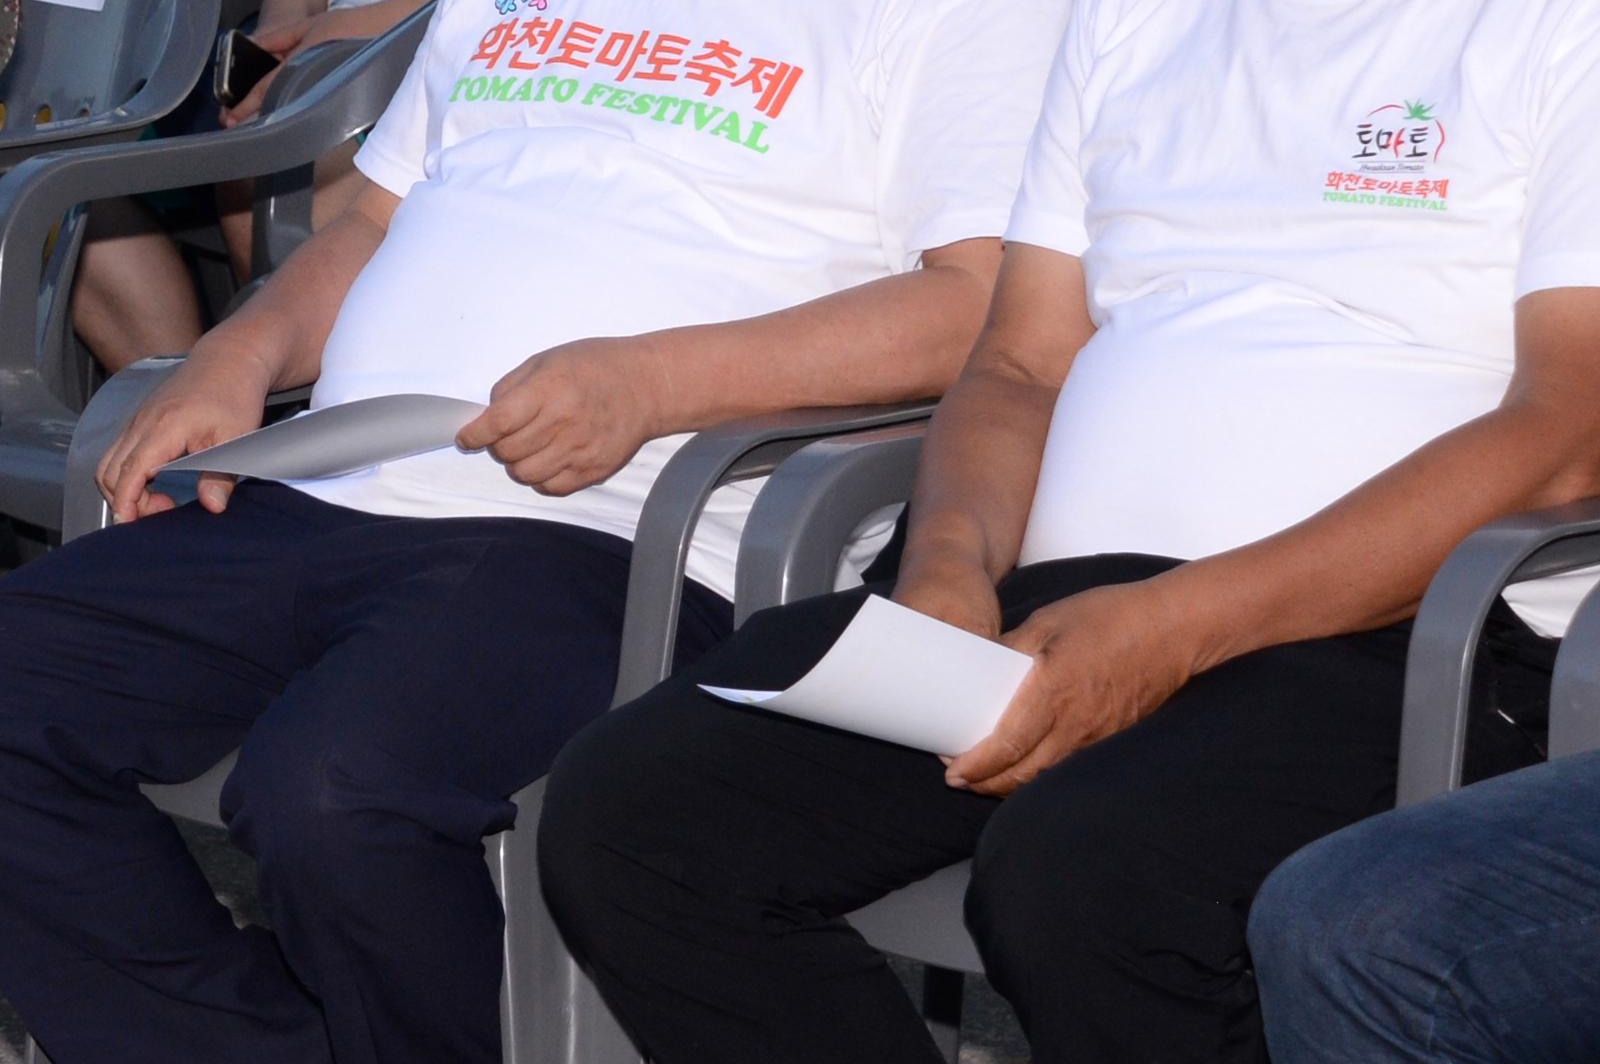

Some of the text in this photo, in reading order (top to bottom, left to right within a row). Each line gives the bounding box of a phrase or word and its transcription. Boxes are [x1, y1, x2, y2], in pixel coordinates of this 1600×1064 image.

[449, 75, 770, 154] TOMATO FESTIVAL
[1351, 123, 1429, 158] 토마토
[1325, 171, 1449, 199] 화천토마토축제
[1323, 191, 1448, 211] TOMATO FESTIVAL
